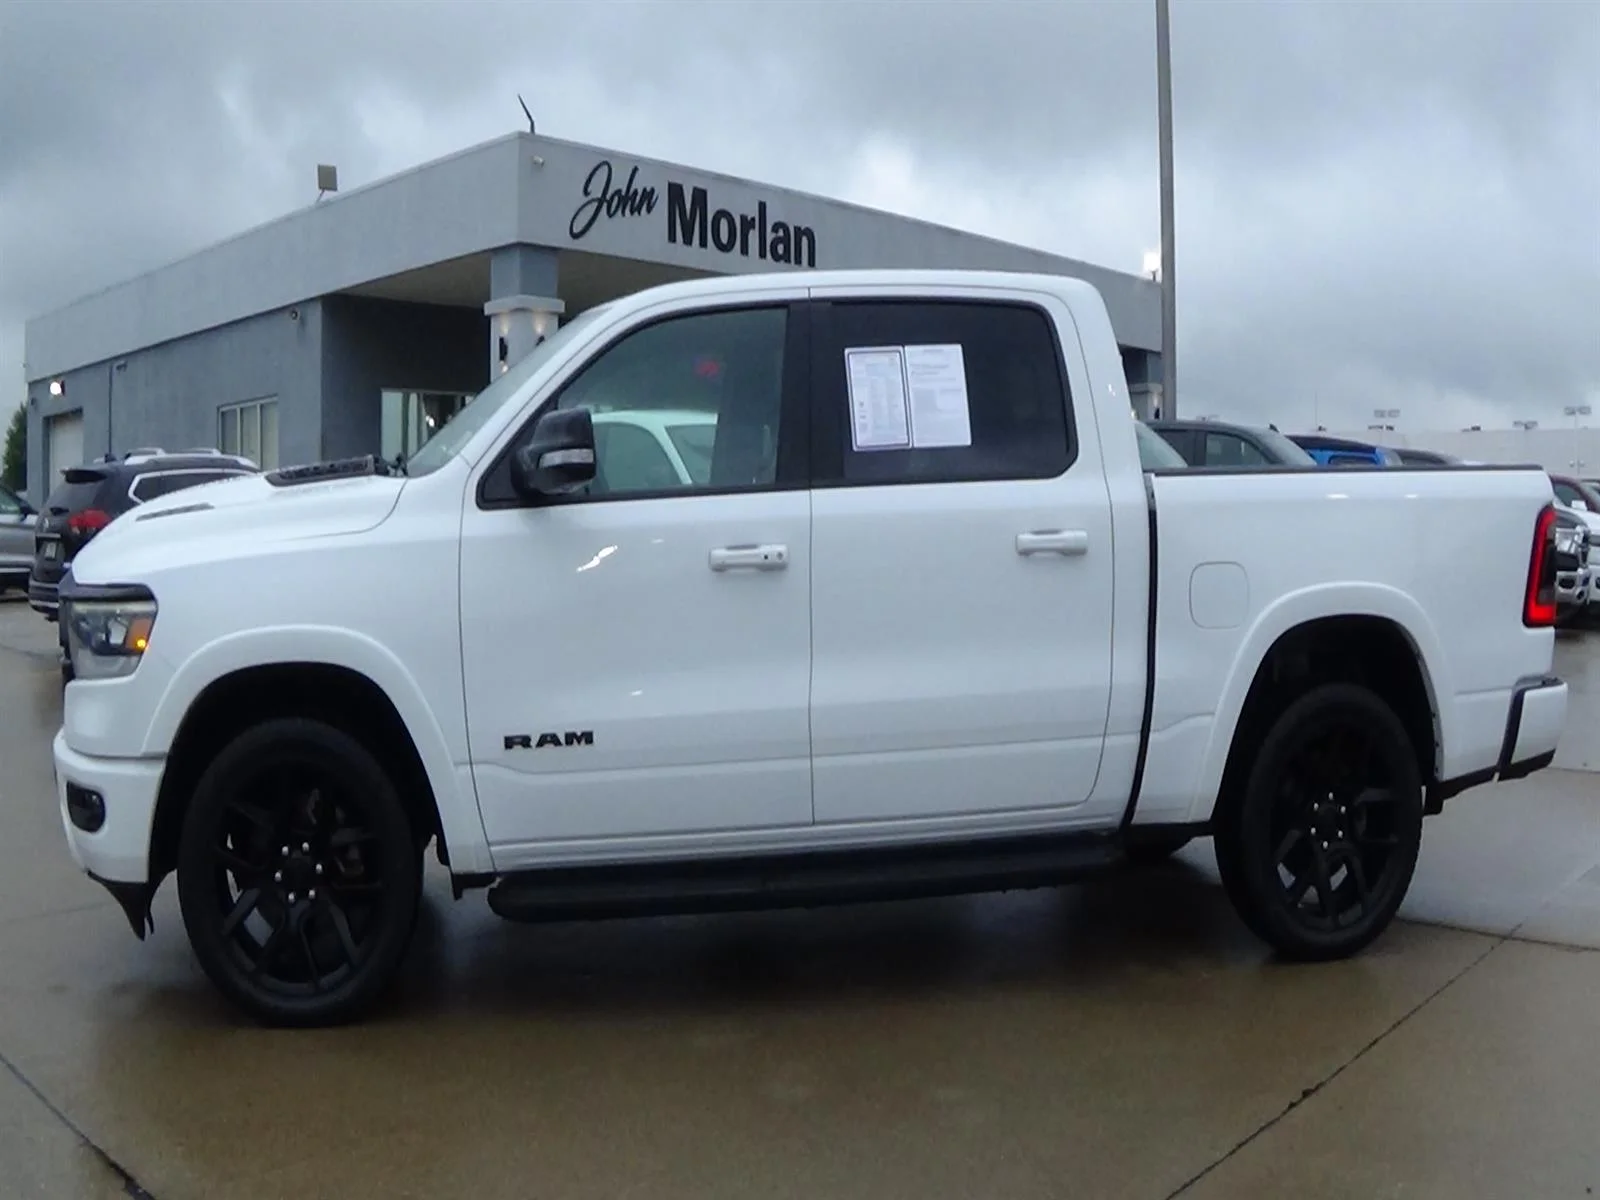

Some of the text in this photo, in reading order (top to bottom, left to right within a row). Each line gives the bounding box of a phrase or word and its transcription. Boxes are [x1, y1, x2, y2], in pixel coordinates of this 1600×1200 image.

[569, 160, 816, 267] John Morlan
[504, 730, 594, 750] RAM
